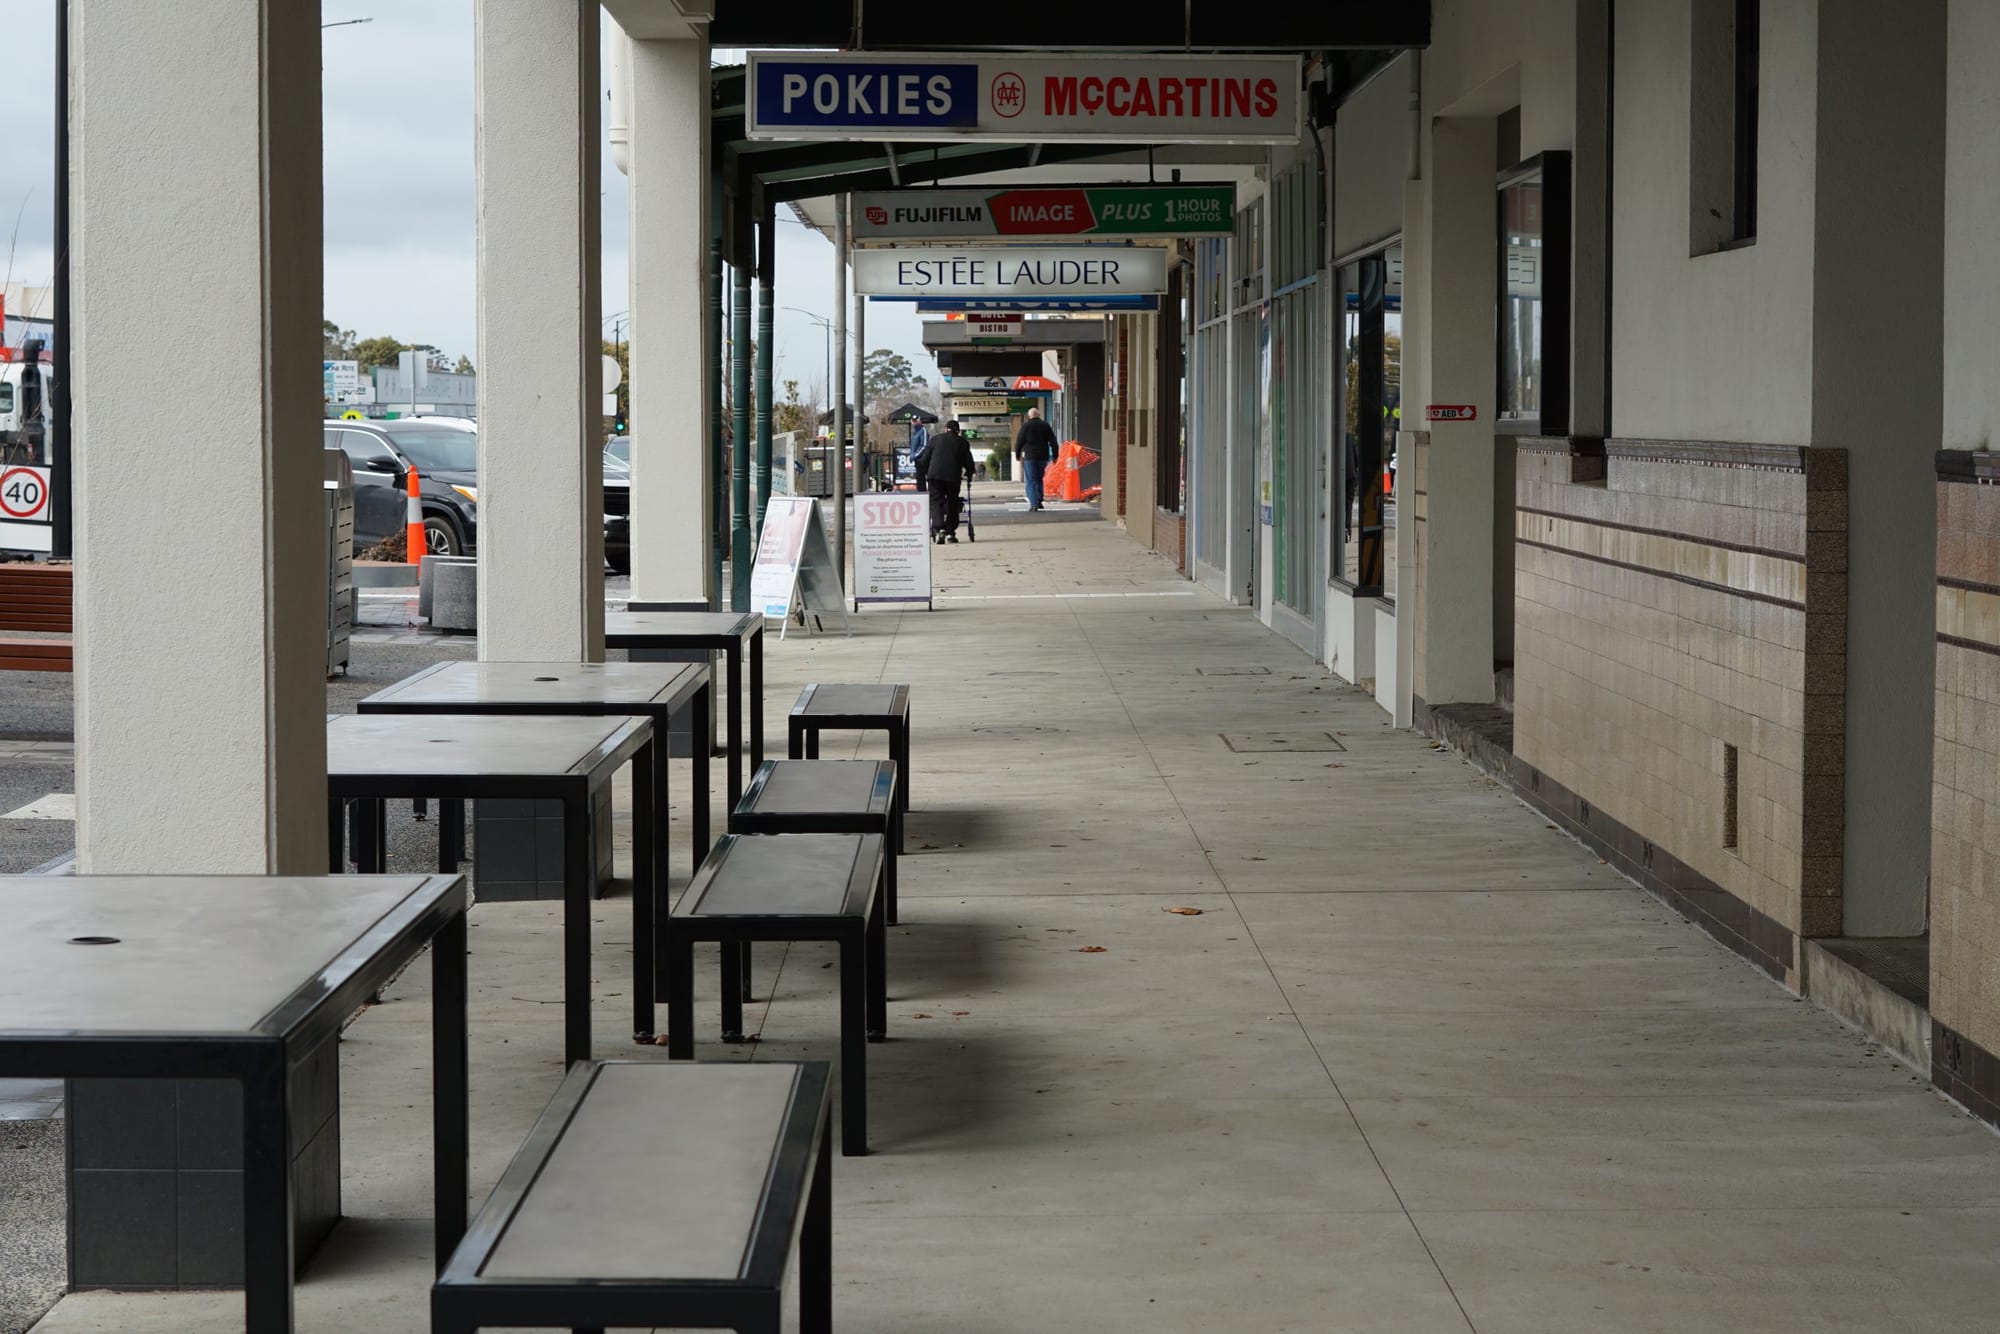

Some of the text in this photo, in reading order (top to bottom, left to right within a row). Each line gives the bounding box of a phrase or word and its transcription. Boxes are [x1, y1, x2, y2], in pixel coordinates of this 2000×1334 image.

[782, 73, 952, 116] POKIES
[894, 207, 982, 223] FUJIFILM
[1010, 204, 1074, 222] IMAGE
[1101, 203, 1153, 221] PLUS
[1164, 199, 1177, 223] 1
[1178, 199, 1220, 212] HOUR
[1178, 211, 1221, 222] PHOTOS
[997, 260, 1121, 286] LAUDER
[979, 324, 1009, 333] BISTRO
[1018, 380, 1040, 388] ATM
[1441, 410, 1457, 418] AED
[5, 481, 39, 505] 40
[863, 501, 922, 526] STOP
